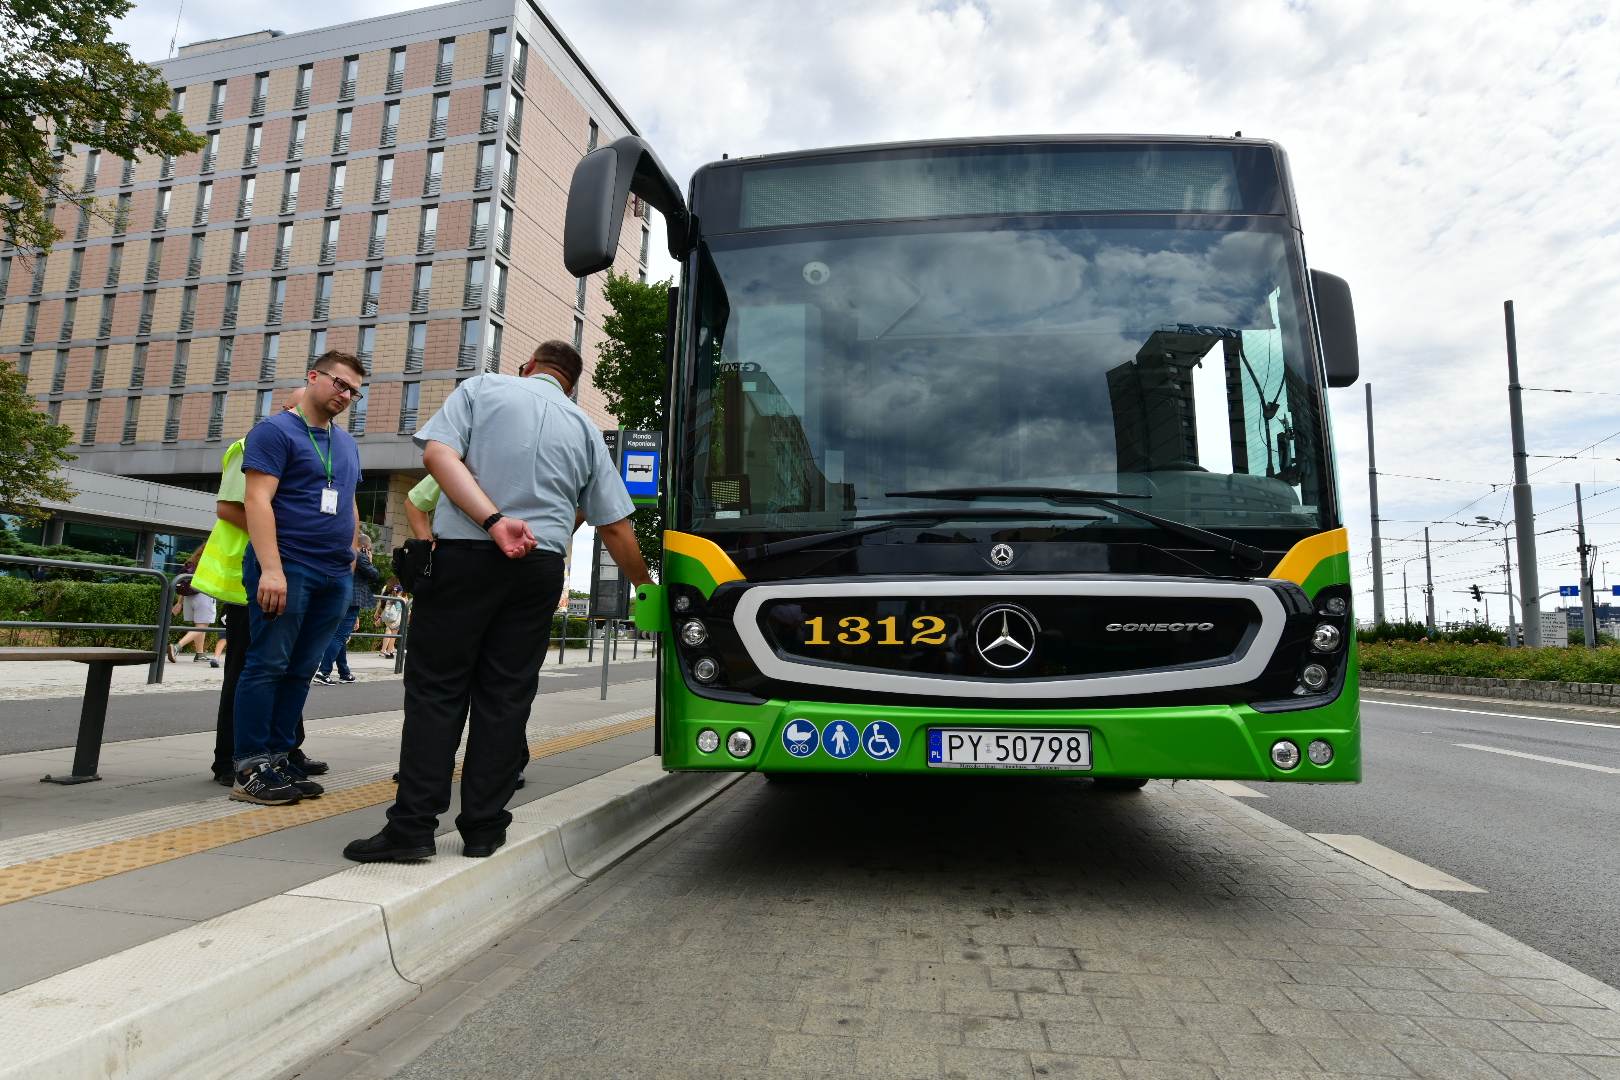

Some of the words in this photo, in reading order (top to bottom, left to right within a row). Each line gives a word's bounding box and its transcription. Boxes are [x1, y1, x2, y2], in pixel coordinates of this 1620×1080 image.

[804, 616, 947, 645] 1312
[1105, 622, 1214, 632] CONECTO
[931, 750, 941, 759] PL
[948, 734, 983, 761] PY
[995, 735, 1082, 763] 50798
